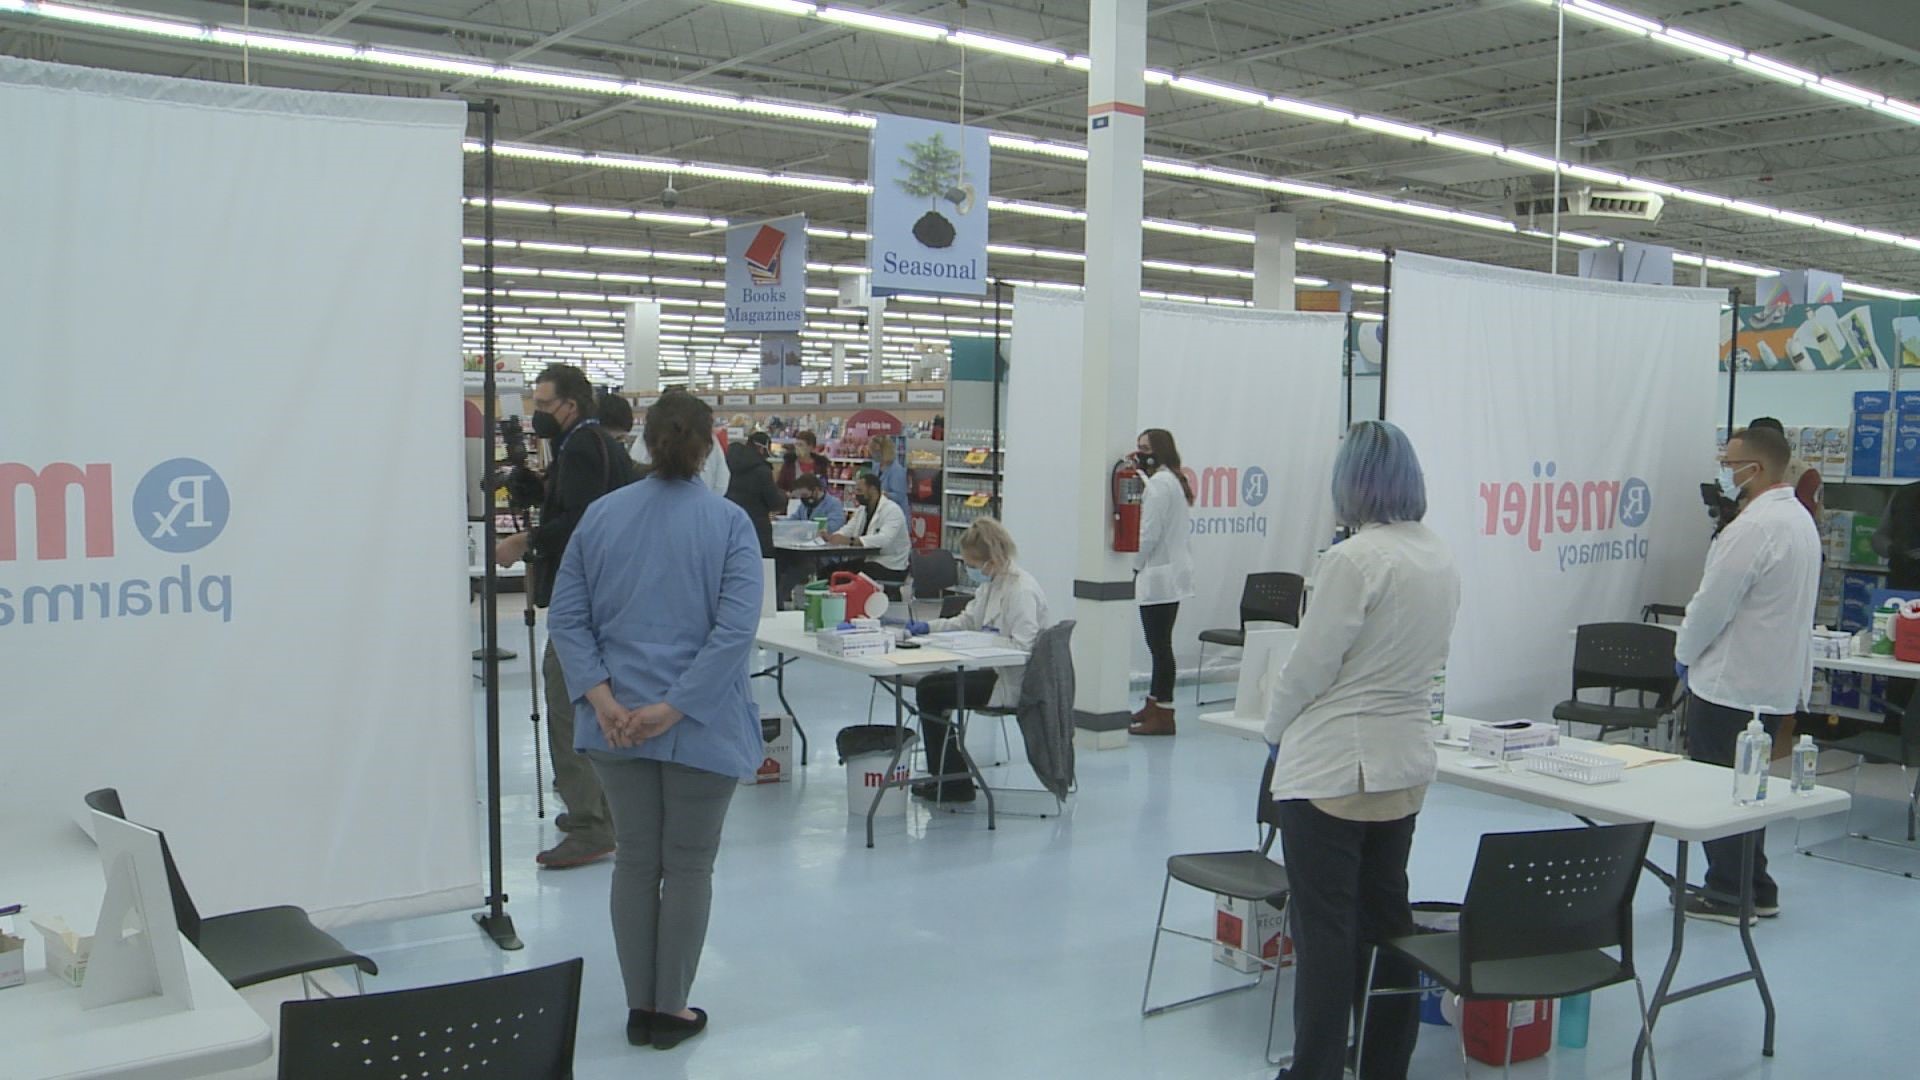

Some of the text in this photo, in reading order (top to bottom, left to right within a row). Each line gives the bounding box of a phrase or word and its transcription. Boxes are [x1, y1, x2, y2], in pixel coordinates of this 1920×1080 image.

[883, 251, 977, 280] Seasonal
[742, 288, 787, 303] Books
[727, 307, 801, 324] Magazines
[1257, 915, 1283, 928] RECO
